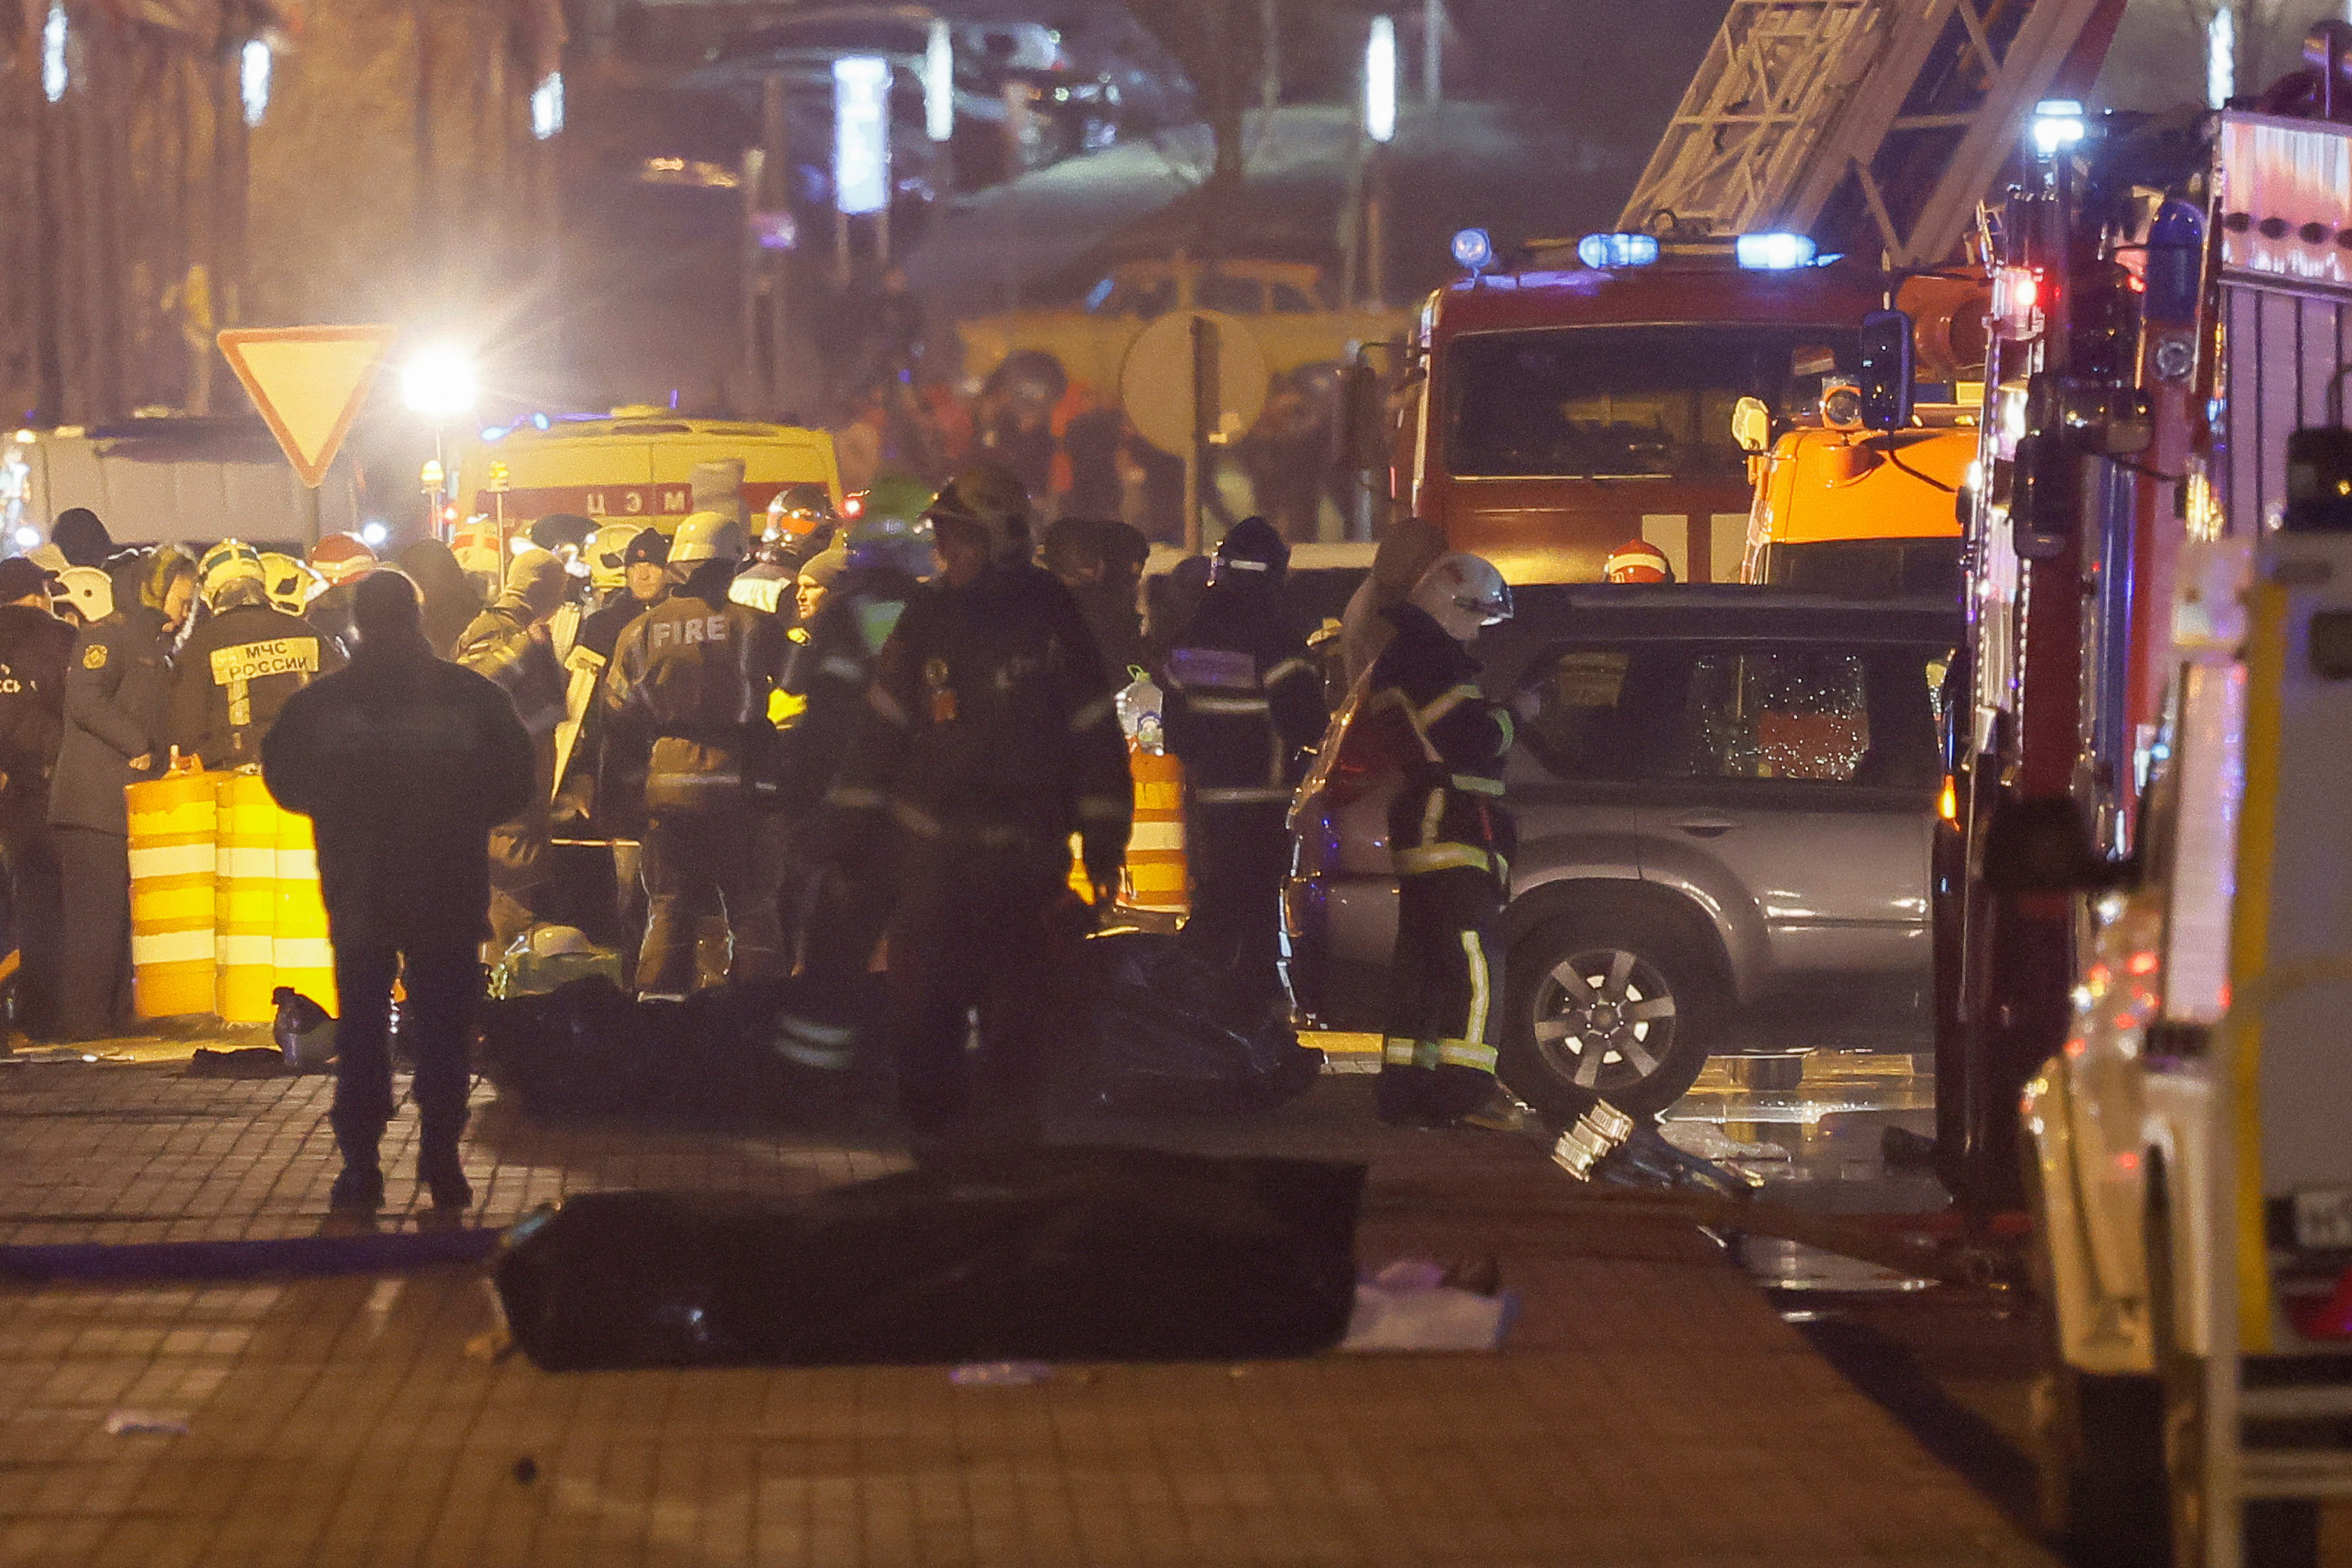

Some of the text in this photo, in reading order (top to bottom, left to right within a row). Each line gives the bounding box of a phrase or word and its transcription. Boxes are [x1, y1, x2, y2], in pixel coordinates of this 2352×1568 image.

[653, 615, 726, 648] FIRE
[246, 642, 287, 659] МЧС
[229, 657, 306, 679] РОССИИ
